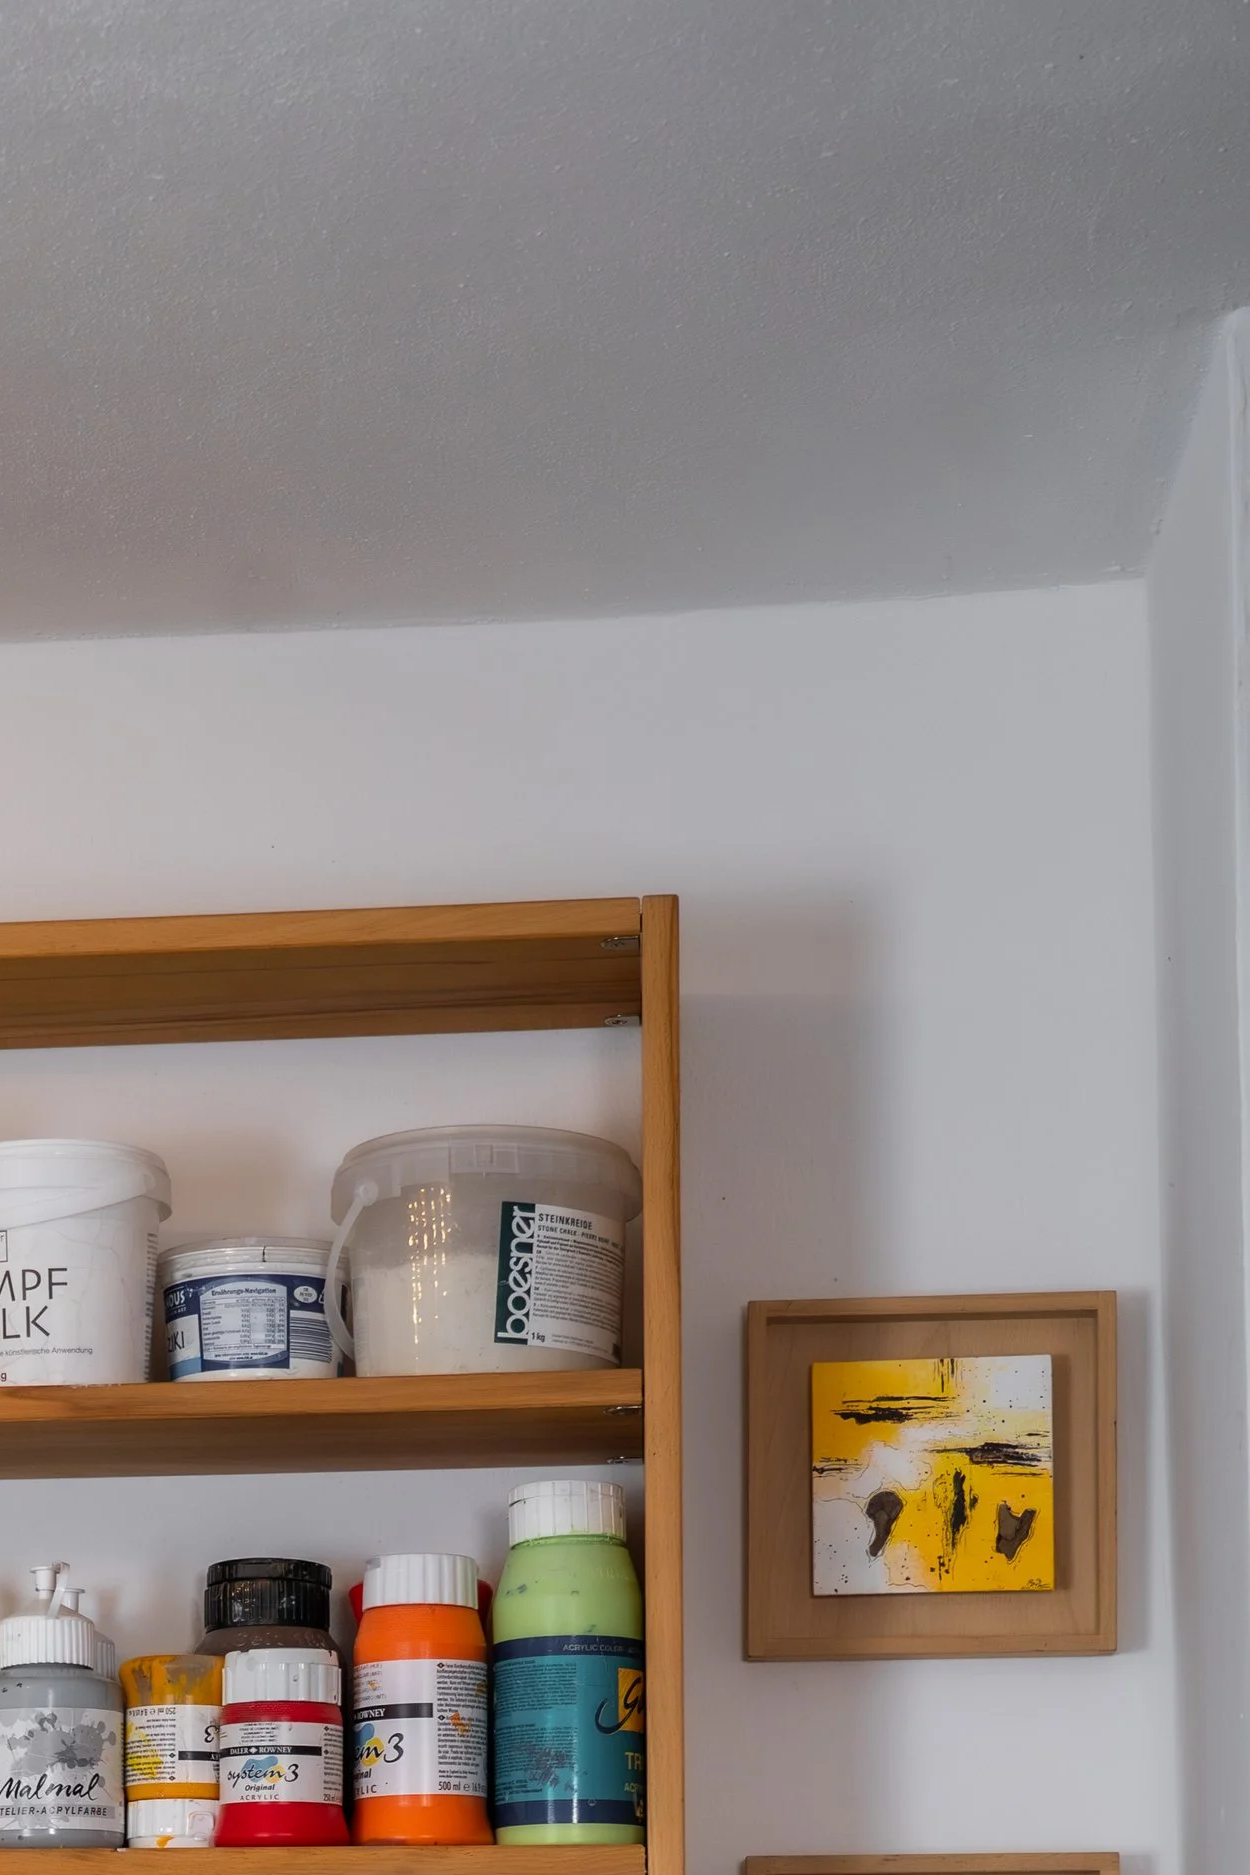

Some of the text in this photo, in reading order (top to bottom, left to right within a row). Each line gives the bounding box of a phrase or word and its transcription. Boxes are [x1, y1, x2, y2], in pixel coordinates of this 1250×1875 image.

[538, 1213, 593, 1230] STEINKREIDE
[497, 1206, 536, 1340] boesner
[531, 1332, 546, 1342] 1 kg
[245, 1784, 275, 1792] Original
[438, 1782, 461, 1790] 500 ml
